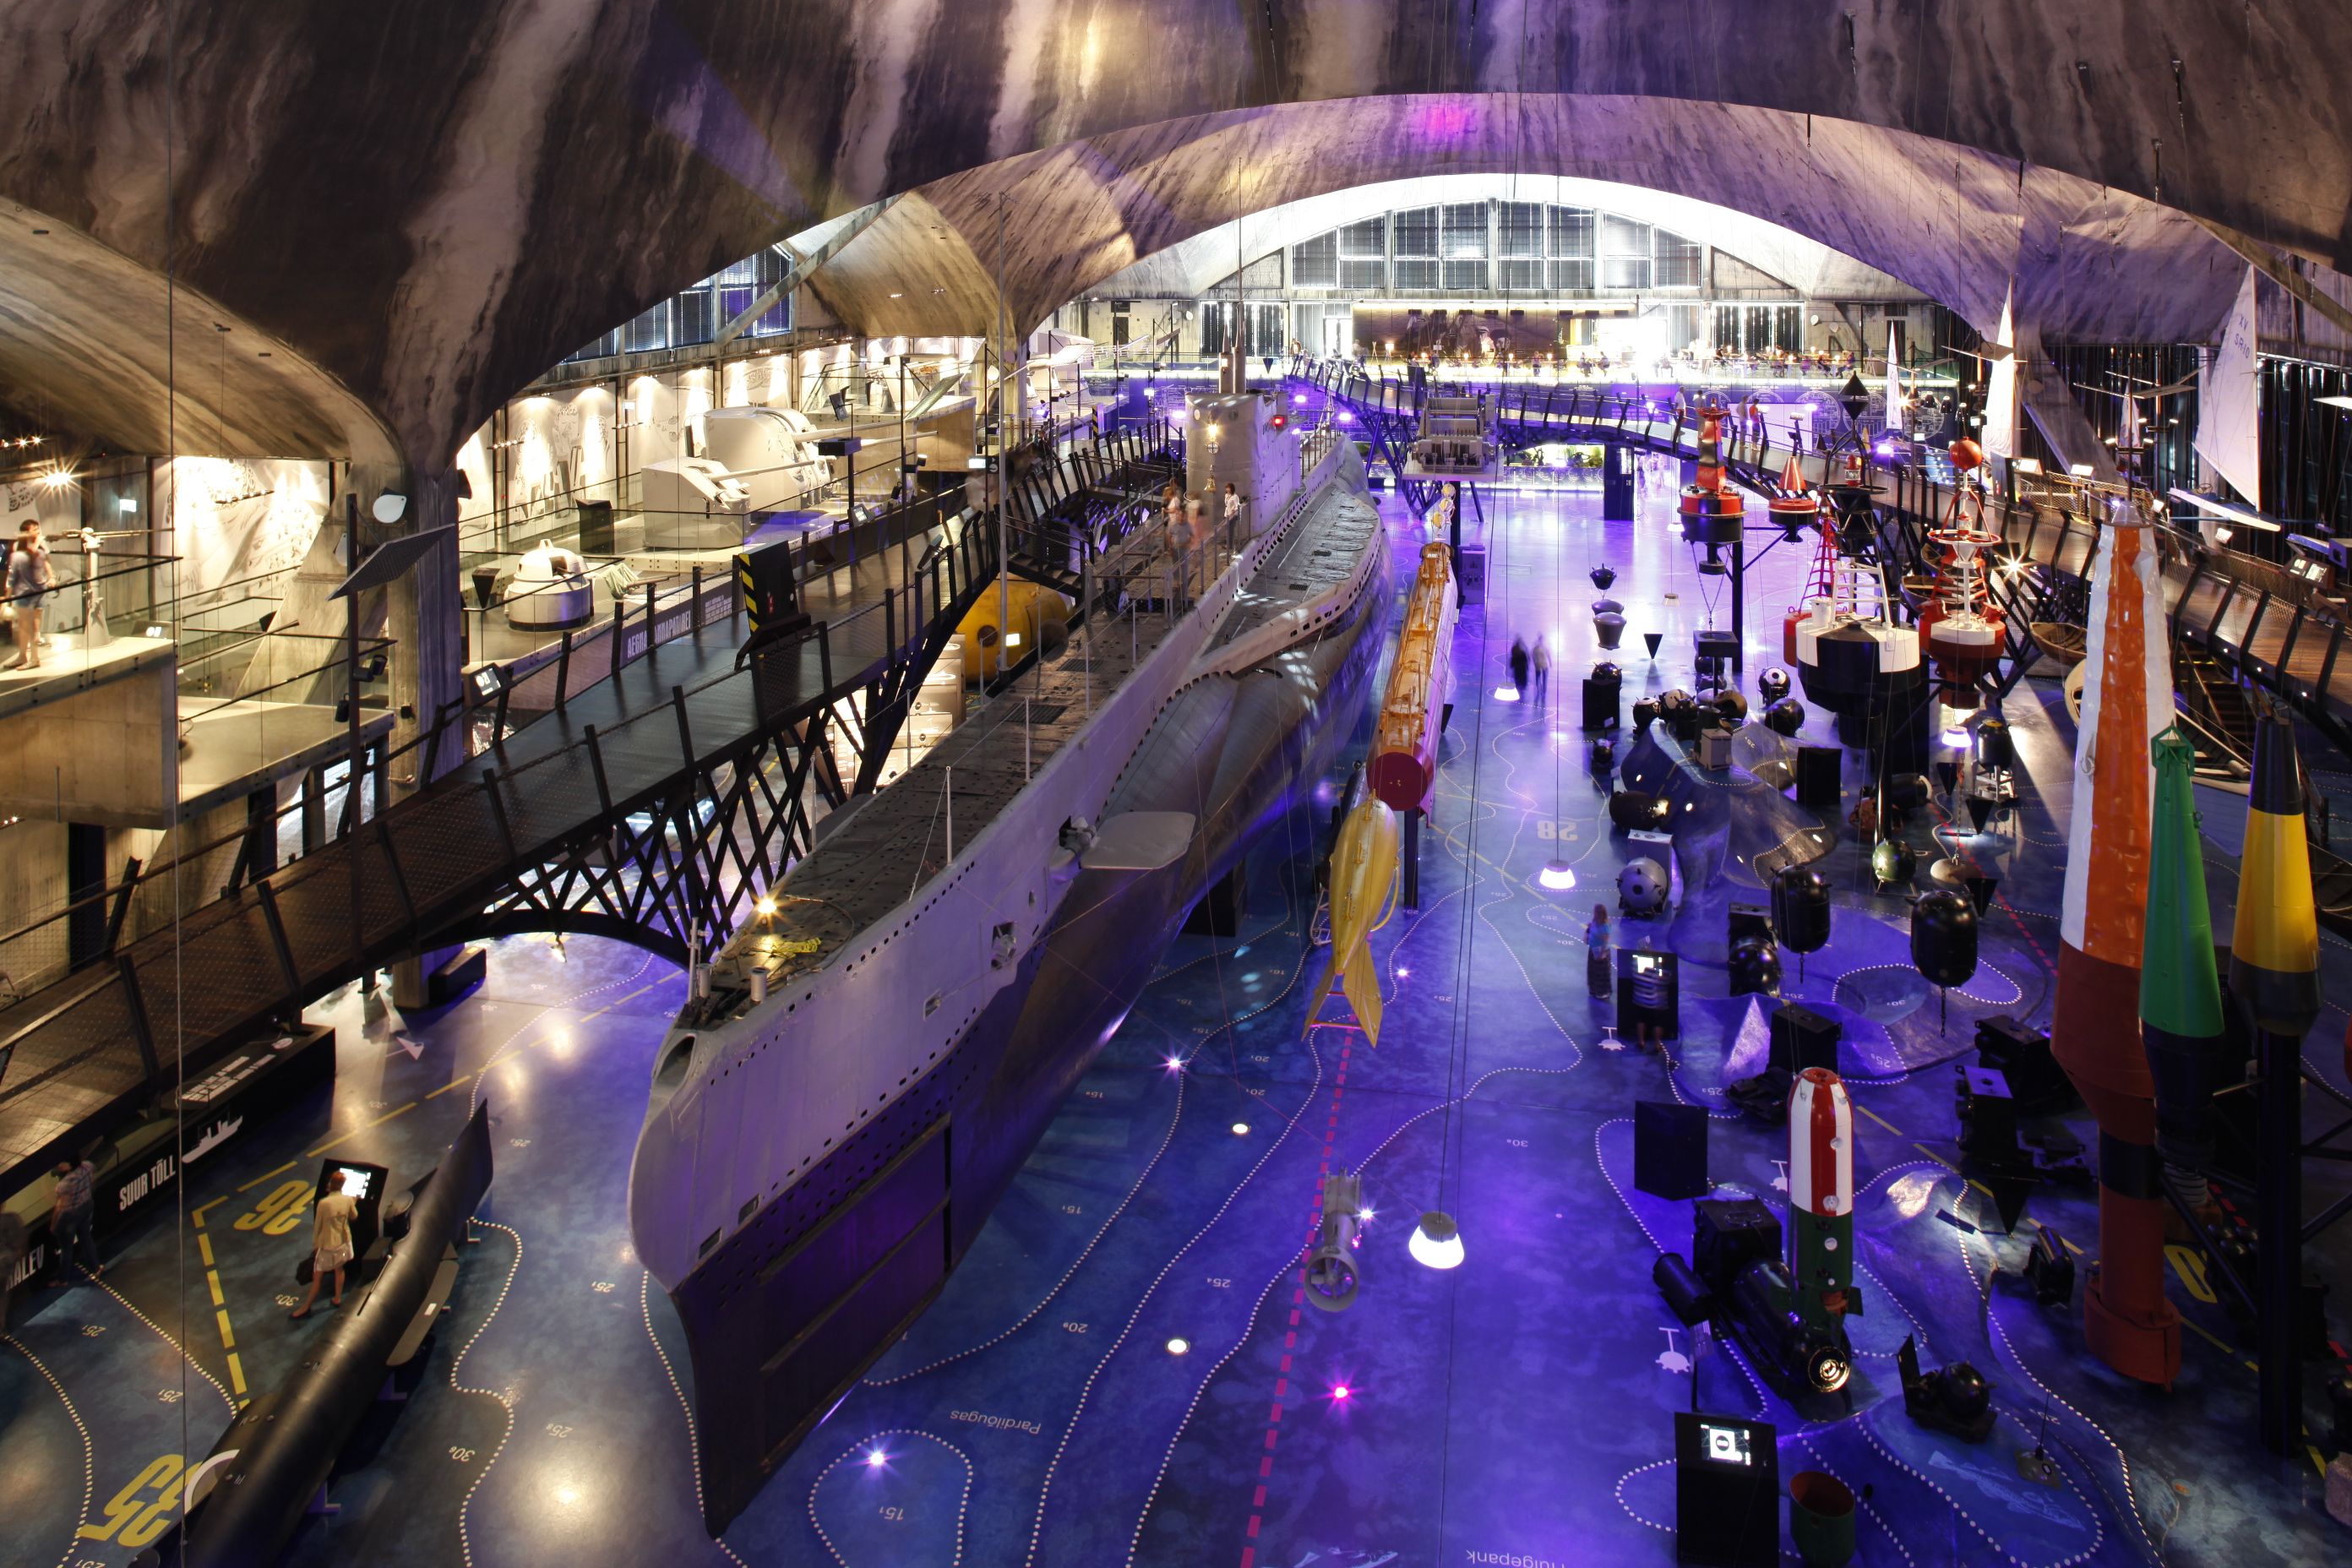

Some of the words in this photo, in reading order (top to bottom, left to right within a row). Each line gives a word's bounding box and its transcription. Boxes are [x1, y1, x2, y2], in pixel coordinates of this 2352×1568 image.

[1537, 819, 1578, 841] 28
[119, 1173, 149, 1211] SUUR
[150, 1155, 177, 1190] TÕLL
[233, 1180, 316, 1236] 36
[1062, 1205, 1082, 1215] 151
[591, 1281, 616, 1293] 251
[82, 1324, 106, 1337] 251
[158, 1389, 183, 1403] 251
[949, 1410, 1042, 1435] Pardilõugas
[546, 1423, 574, 1439] 258
[449, 1446, 476, 1462] 306
[77, 1454, 207, 1547] 35
[879, 1506, 904, 1521] 151
